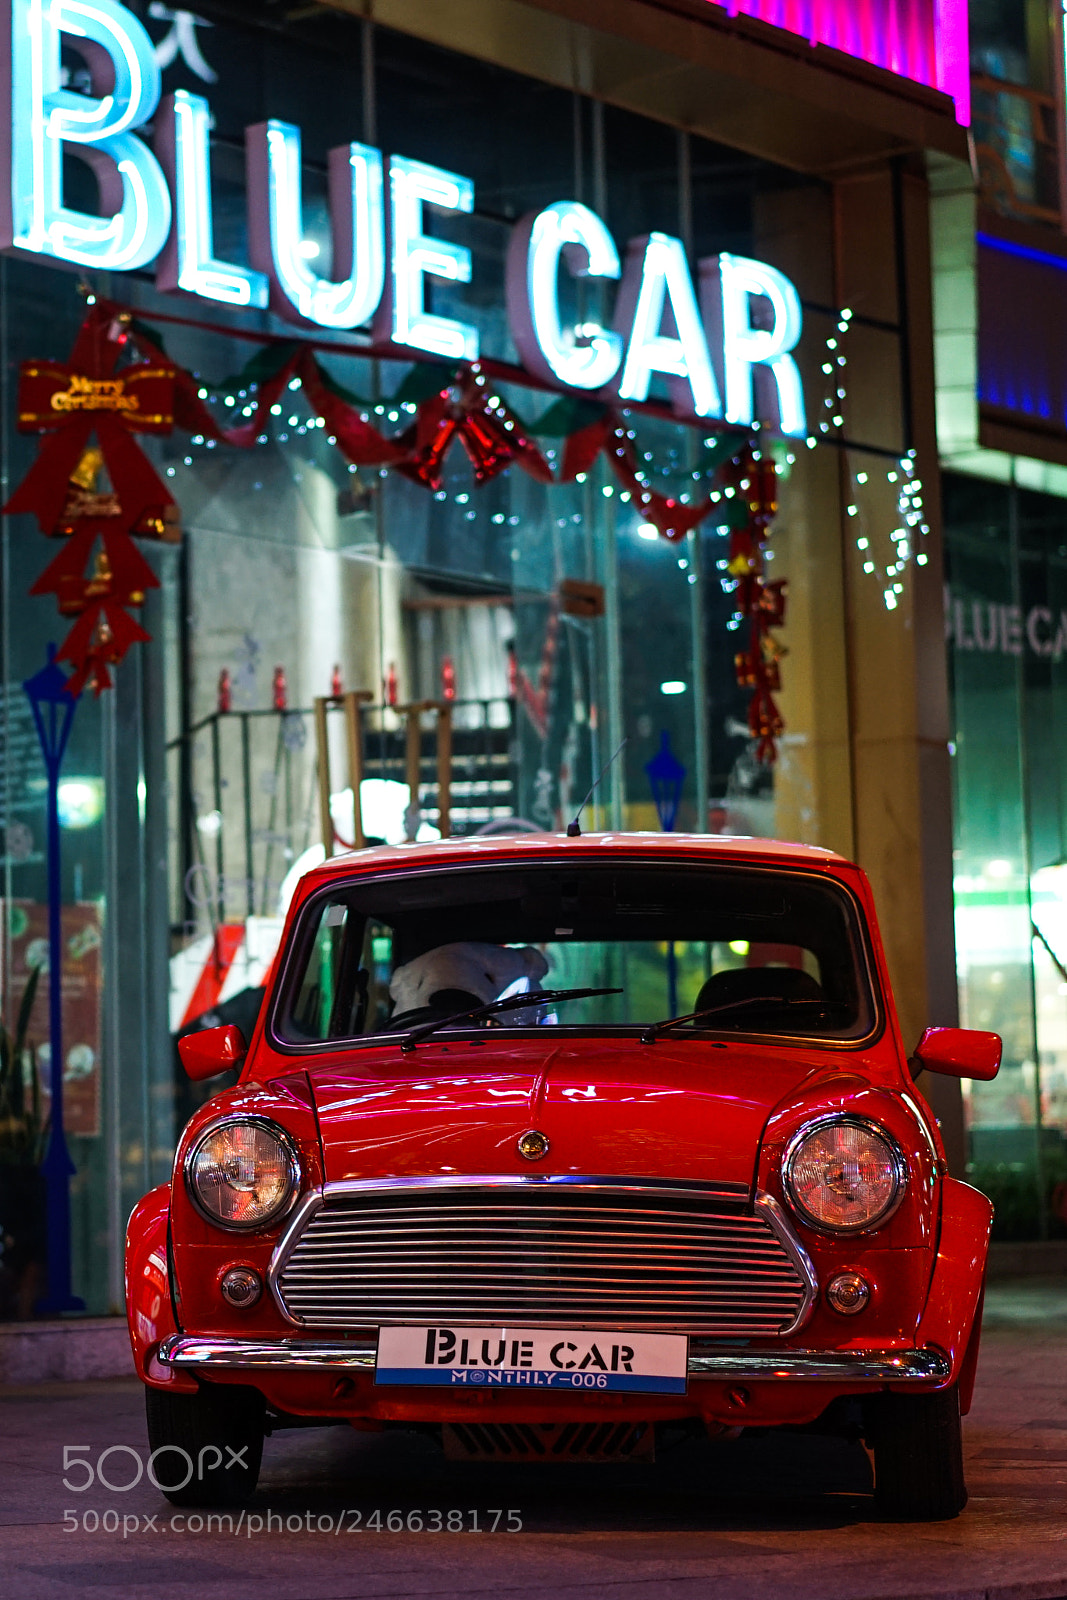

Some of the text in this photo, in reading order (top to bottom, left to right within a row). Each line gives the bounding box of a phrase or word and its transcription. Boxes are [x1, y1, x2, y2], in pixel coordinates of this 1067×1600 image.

[12, 0, 807, 438] BLUE CAR
[944, 585, 1022, 654] LUE
[424, 1329, 635, 1373] BLUE CAR
